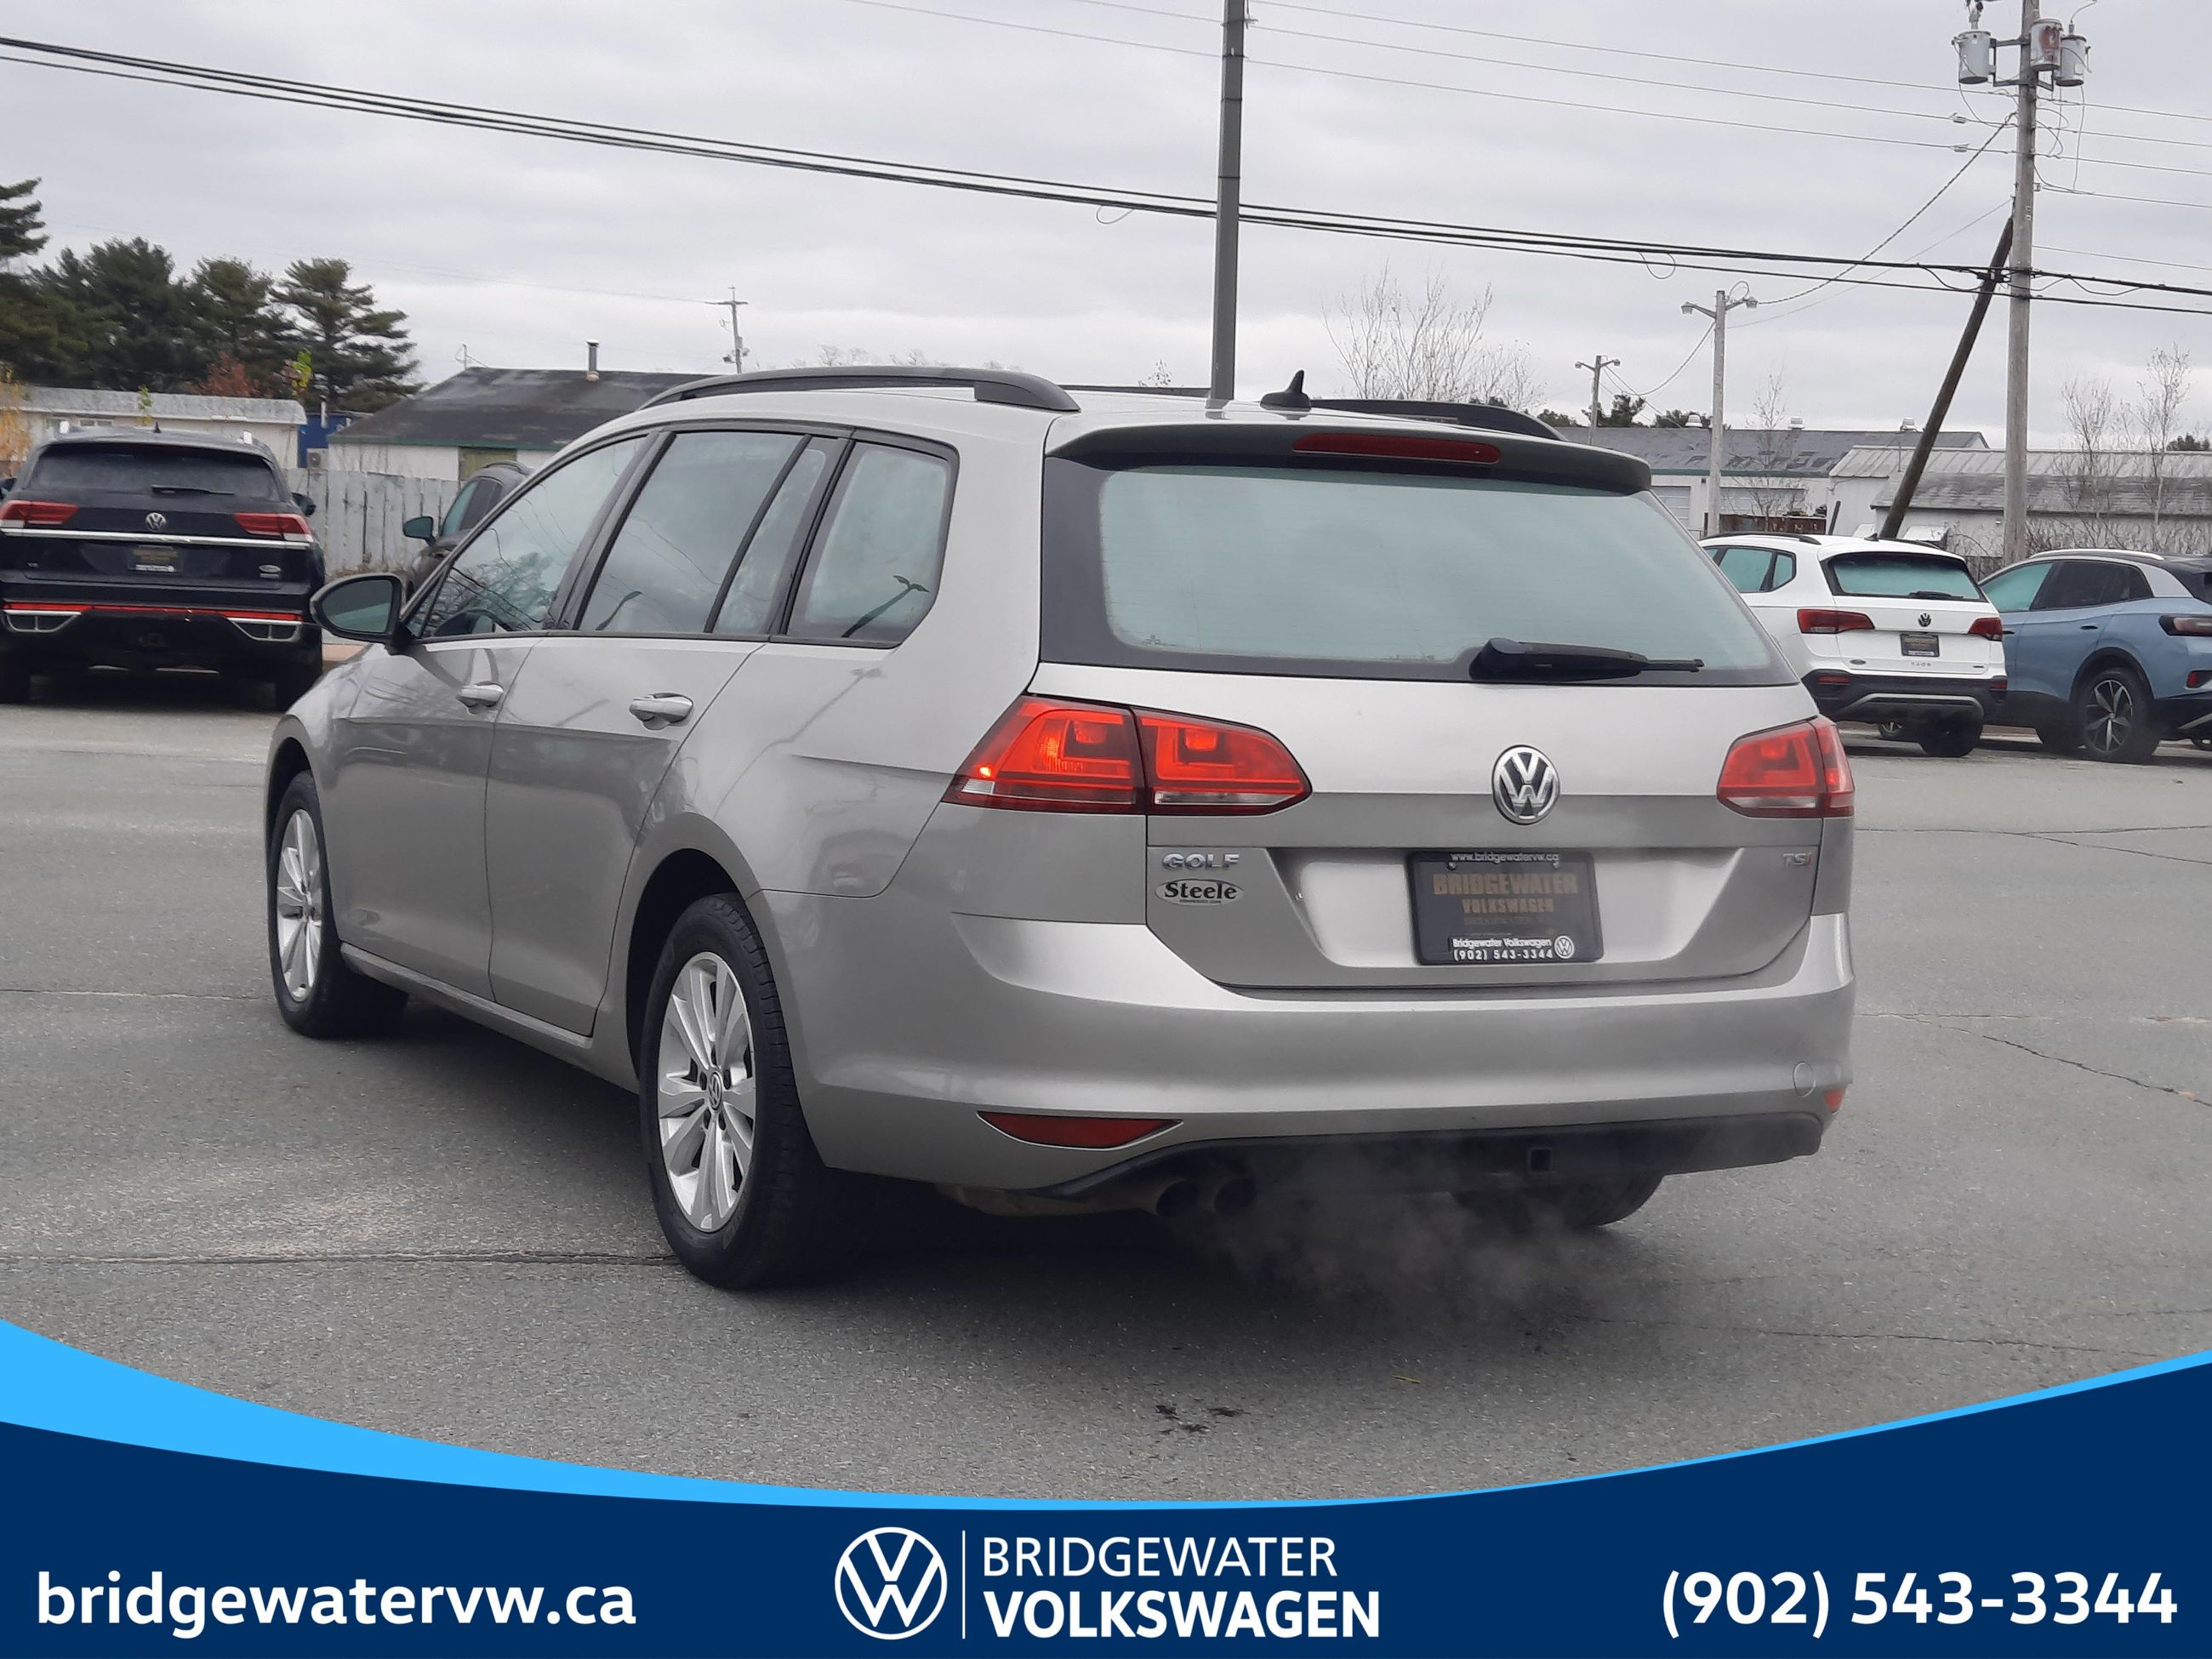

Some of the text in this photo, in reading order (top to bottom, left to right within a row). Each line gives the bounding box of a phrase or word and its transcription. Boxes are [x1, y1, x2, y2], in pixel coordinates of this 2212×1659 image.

[1491, 744, 1560, 825] VW
[1162, 852, 1240, 869] GOLF
[1450, 852, 1559, 864] www.bridgewatervw.ca
[1164, 882, 1238, 899] Steele
[1433, 873, 1579, 895] BRIDGEWATER
[1462, 898, 1554, 914] VOLKSWAGEN
[1452, 938, 1552, 949] Bridgewater Volkswagen
[1554, 936, 1575, 959] VW
[1453, 948, 1554, 961] (902) 543-3344
